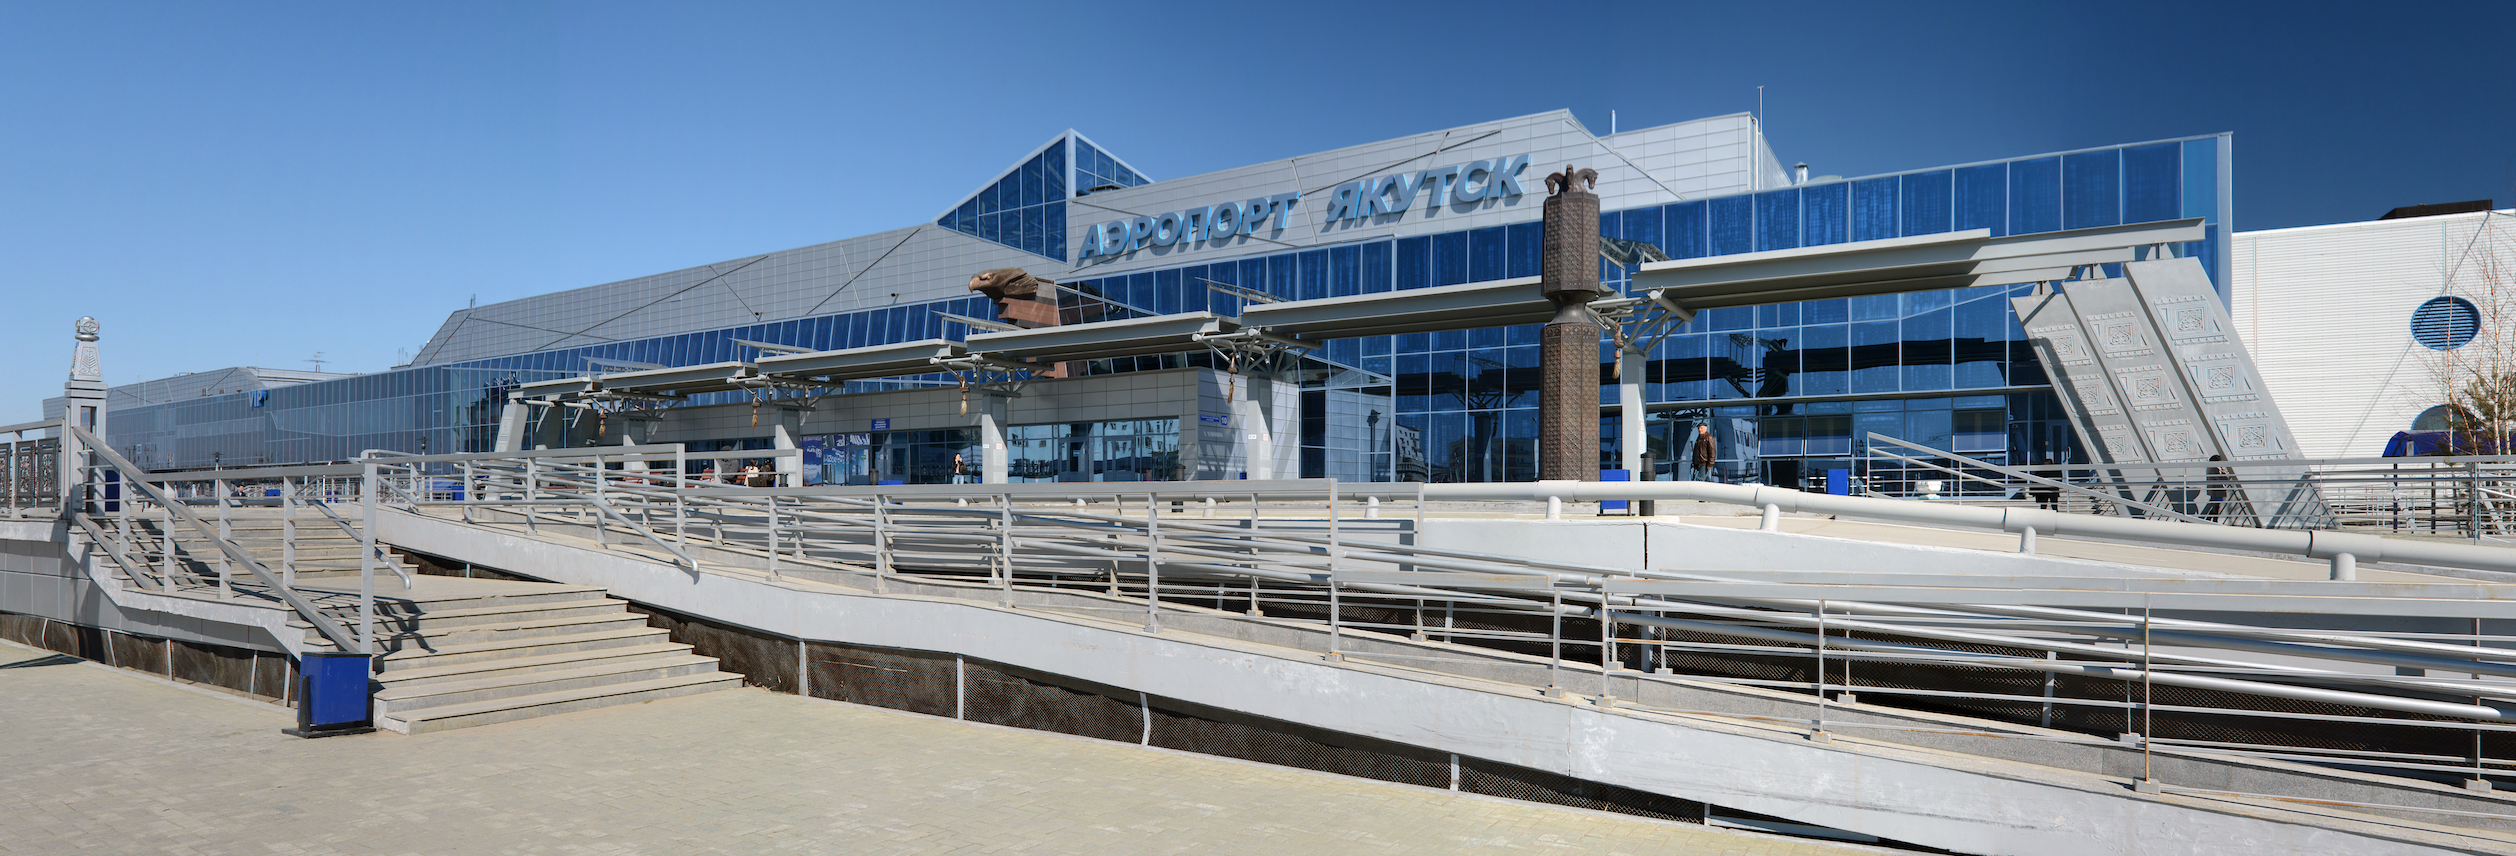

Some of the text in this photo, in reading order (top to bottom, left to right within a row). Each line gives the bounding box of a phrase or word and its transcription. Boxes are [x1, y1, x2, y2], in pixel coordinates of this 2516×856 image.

[1078, 153, 1531, 259] АЭРОПОРТ ЯКУТСК
[248, 390, 265, 407] VIP
[1221, 416, 1227, 424] 10
